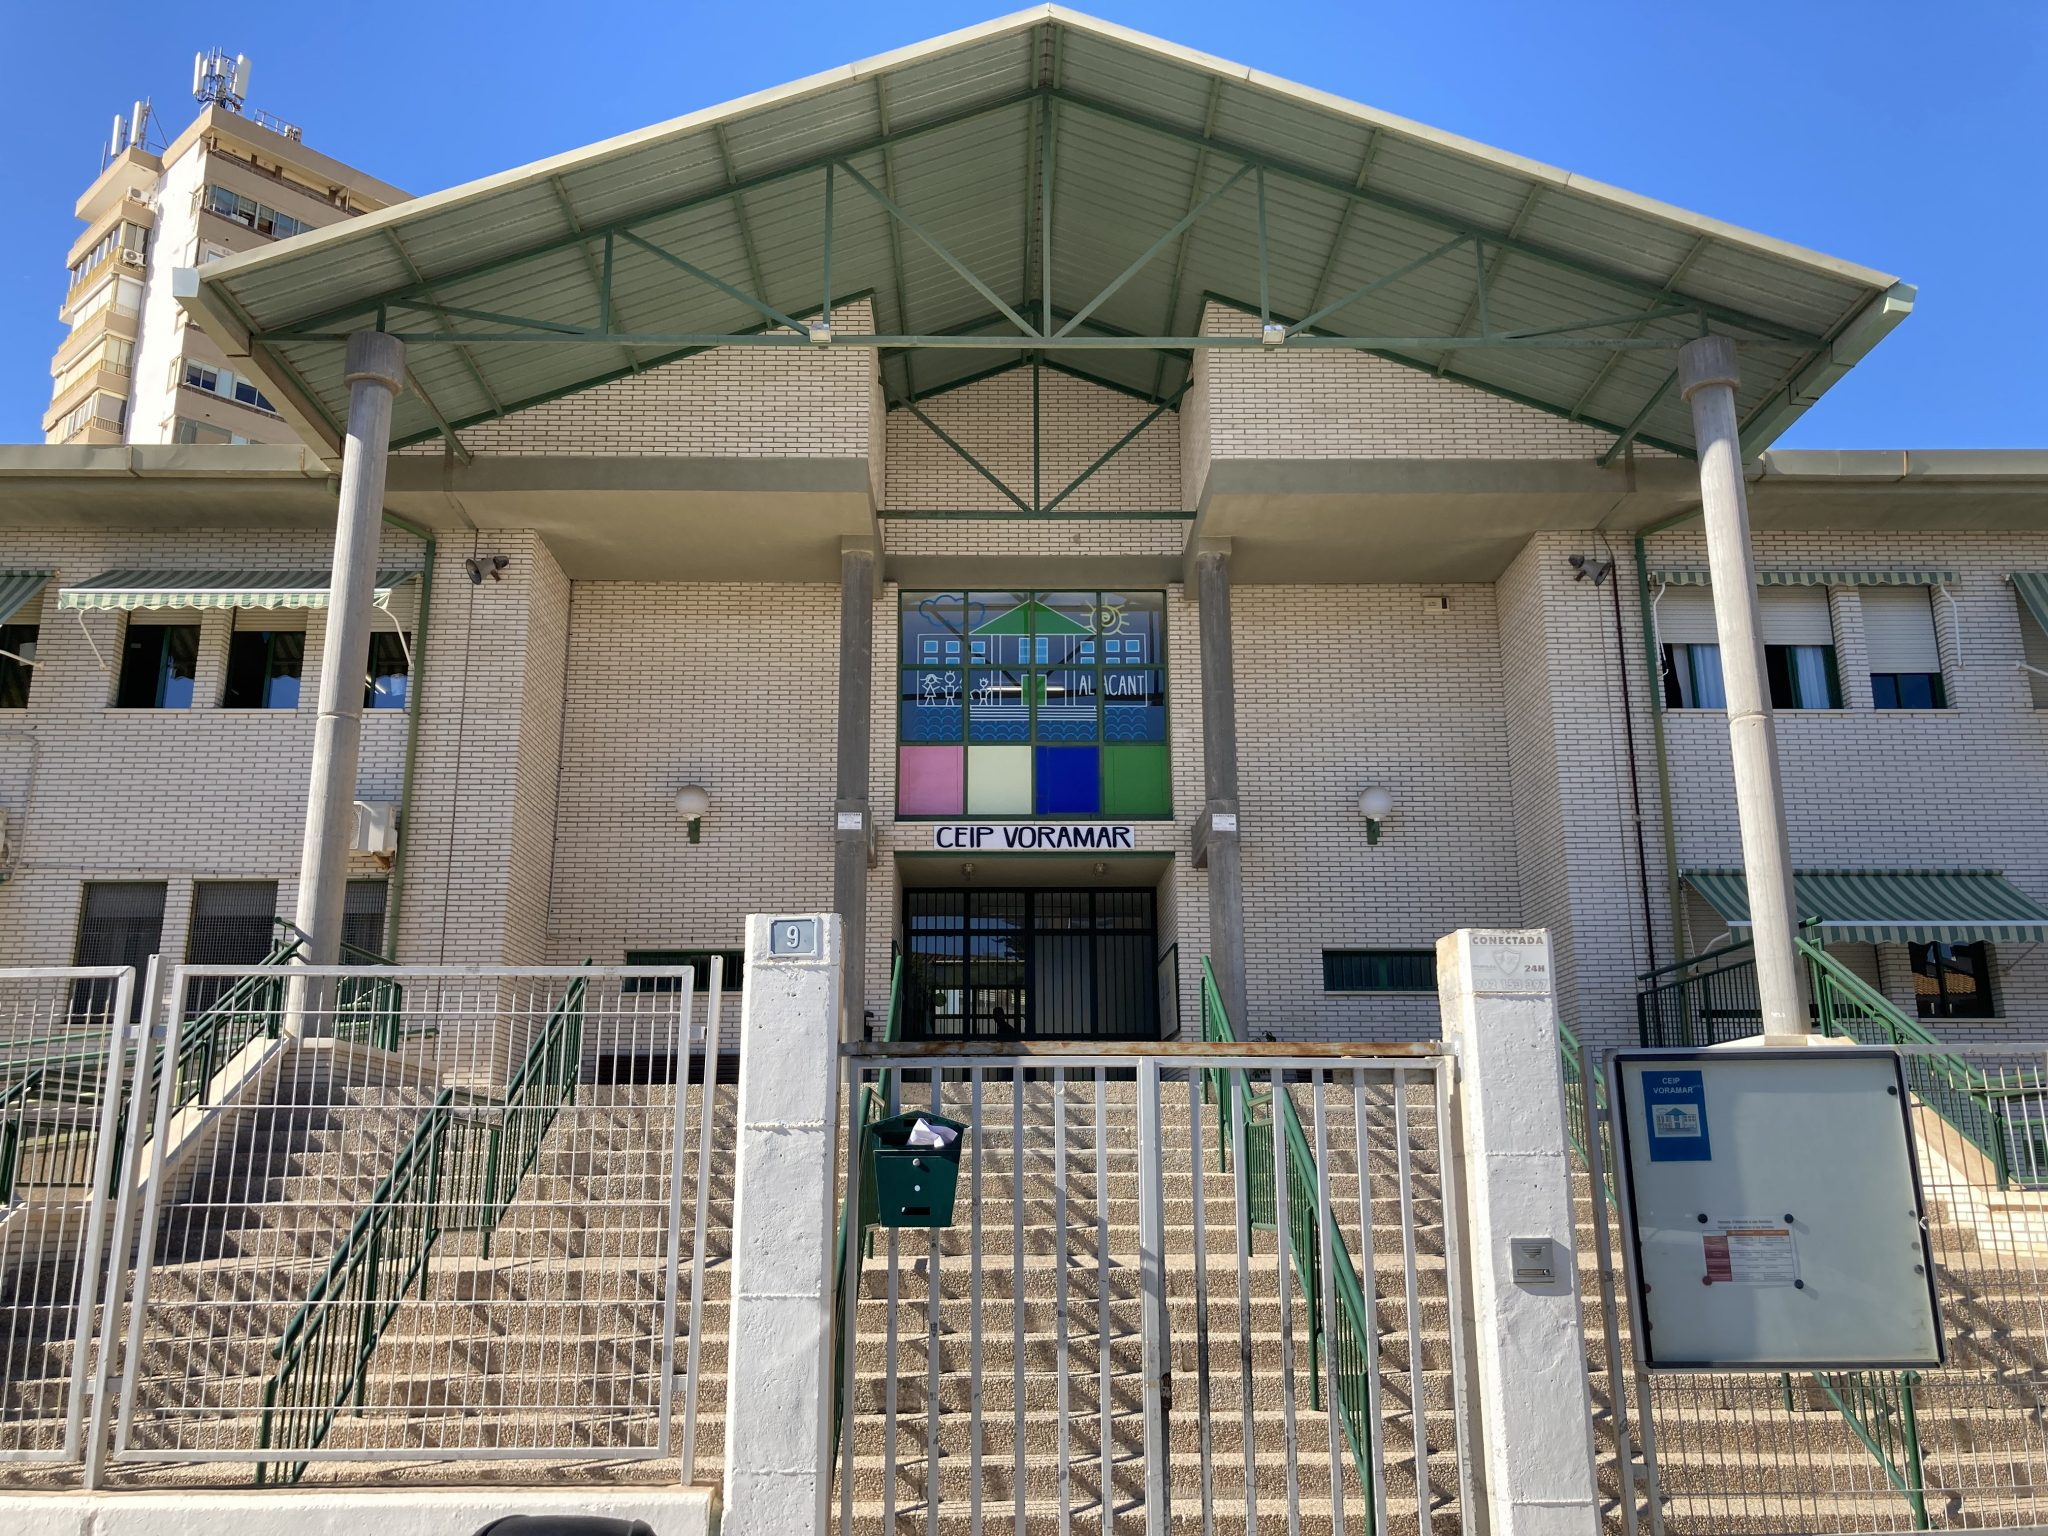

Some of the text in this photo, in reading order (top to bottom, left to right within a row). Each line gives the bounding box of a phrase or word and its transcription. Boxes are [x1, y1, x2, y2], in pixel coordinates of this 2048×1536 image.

[936, 826, 1132, 849] CEIP VORAMAR
[786, 925, 800, 948] 9
[1472, 936, 1544, 945] CONECTADA
[1524, 964, 1545, 973] 24H
[1653, 1086, 1693, 1094] VORAMAR
